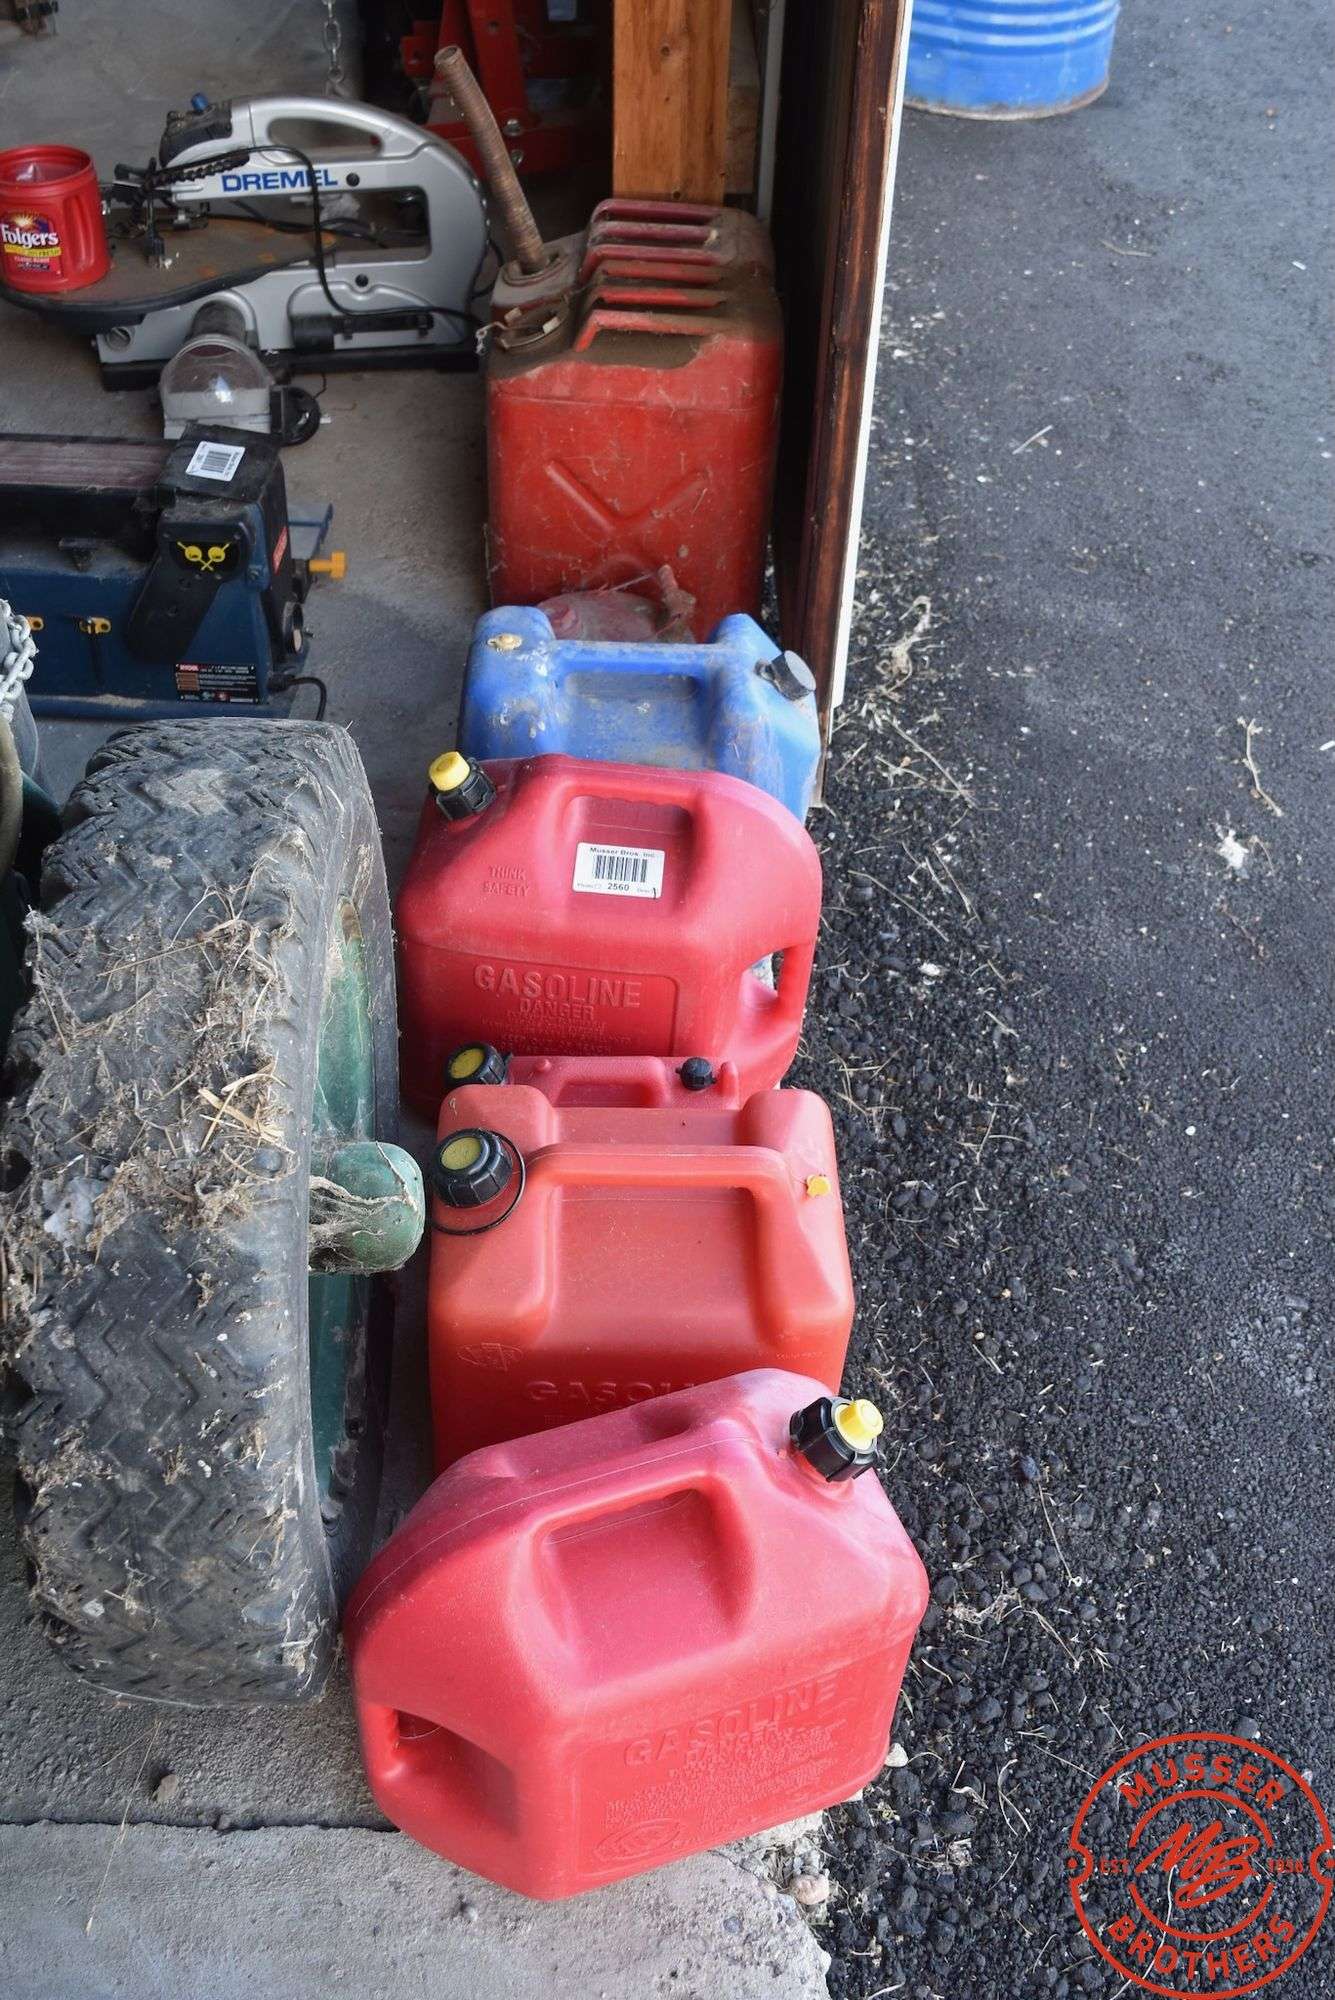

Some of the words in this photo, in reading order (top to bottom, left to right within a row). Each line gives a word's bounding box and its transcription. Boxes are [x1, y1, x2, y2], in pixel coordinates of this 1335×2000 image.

[221, 168, 338, 192] DREMEL
[0, 223, 60, 249] Folgers
[589, 847, 618, 855] Musser
[489, 864, 527, 881] THINK
[483, 881, 530, 897] SAFETY
[607, 882, 630, 892] 2560
[474, 964, 643, 1009] GASOLINE
[519, 998, 595, 1022] DANGER
[623, 1671, 838, 1767] GASOLINE
